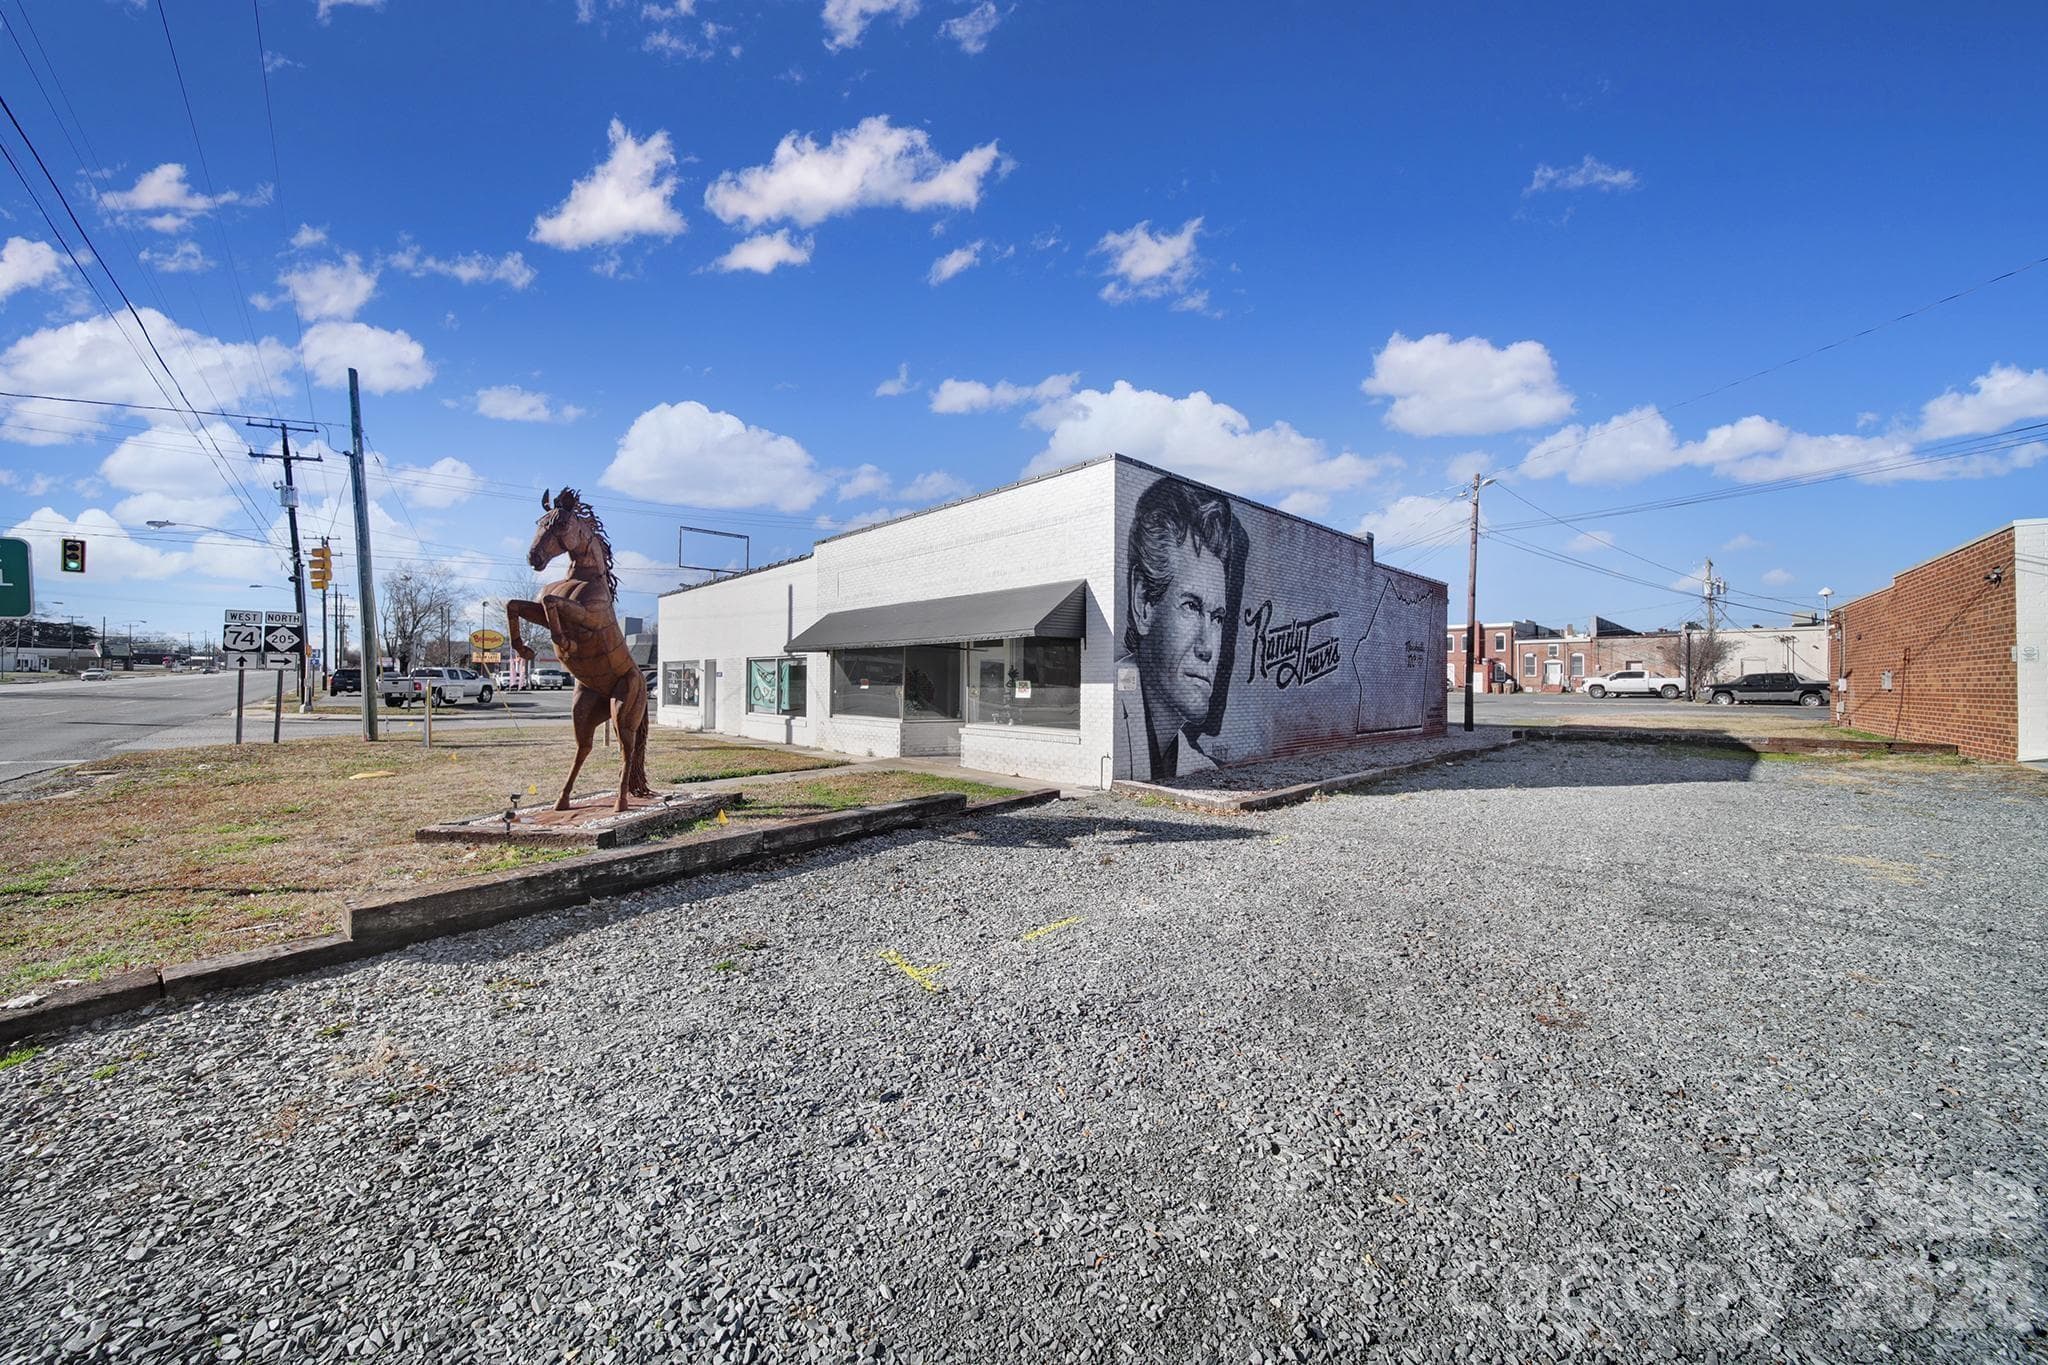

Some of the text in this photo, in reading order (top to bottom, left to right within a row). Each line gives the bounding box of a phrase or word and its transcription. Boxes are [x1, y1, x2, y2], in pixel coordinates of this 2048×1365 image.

[230, 612, 257, 621] WEST
[267, 613, 300, 623] NORTH
[229, 630, 255, 646] 74
[271, 634, 295, 644] 205
[1244, 599, 1303, 689] Randy
